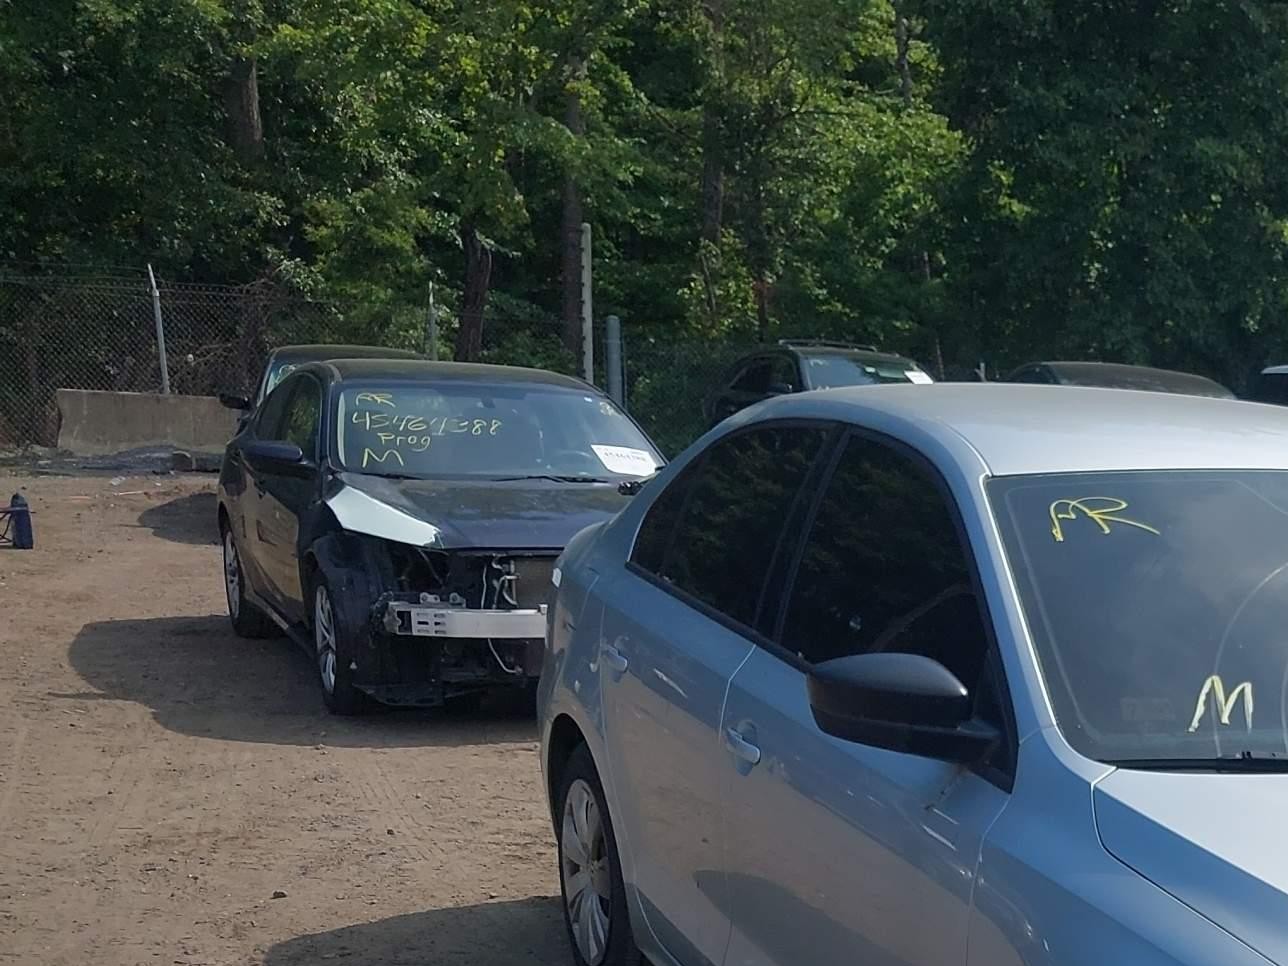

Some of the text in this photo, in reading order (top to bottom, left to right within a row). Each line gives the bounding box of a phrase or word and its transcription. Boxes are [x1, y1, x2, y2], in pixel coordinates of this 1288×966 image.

[377, 432, 430, 452] Prog
[362, 448, 404, 468] M
[1187, 674, 1254, 734] M
